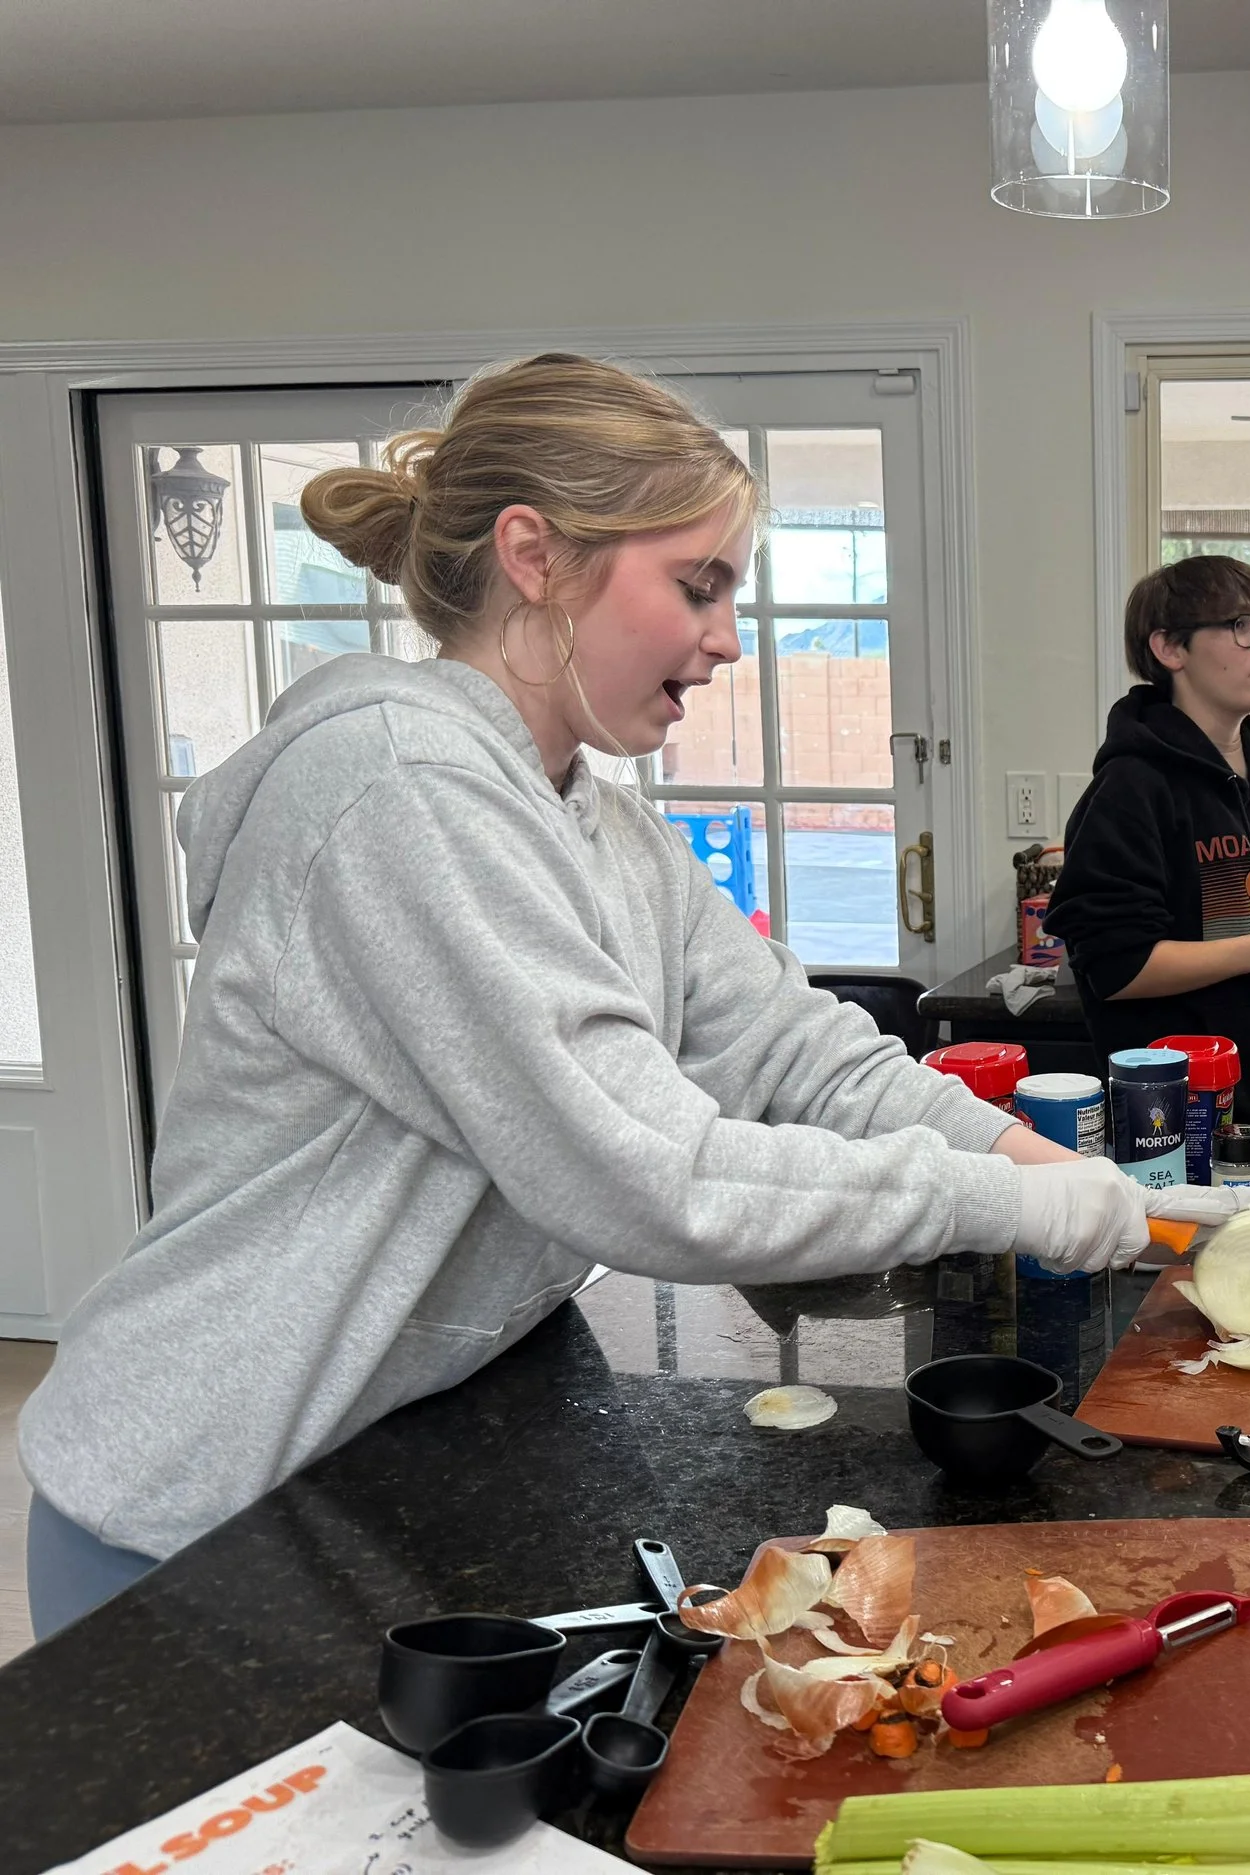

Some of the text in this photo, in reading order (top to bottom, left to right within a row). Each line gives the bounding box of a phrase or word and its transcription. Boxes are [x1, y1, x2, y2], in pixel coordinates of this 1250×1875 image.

[1135, 1132, 1182, 1149] MORTON
[1149, 1169, 1173, 1181] SEA
[159, 1765, 328, 1863] SOUP
